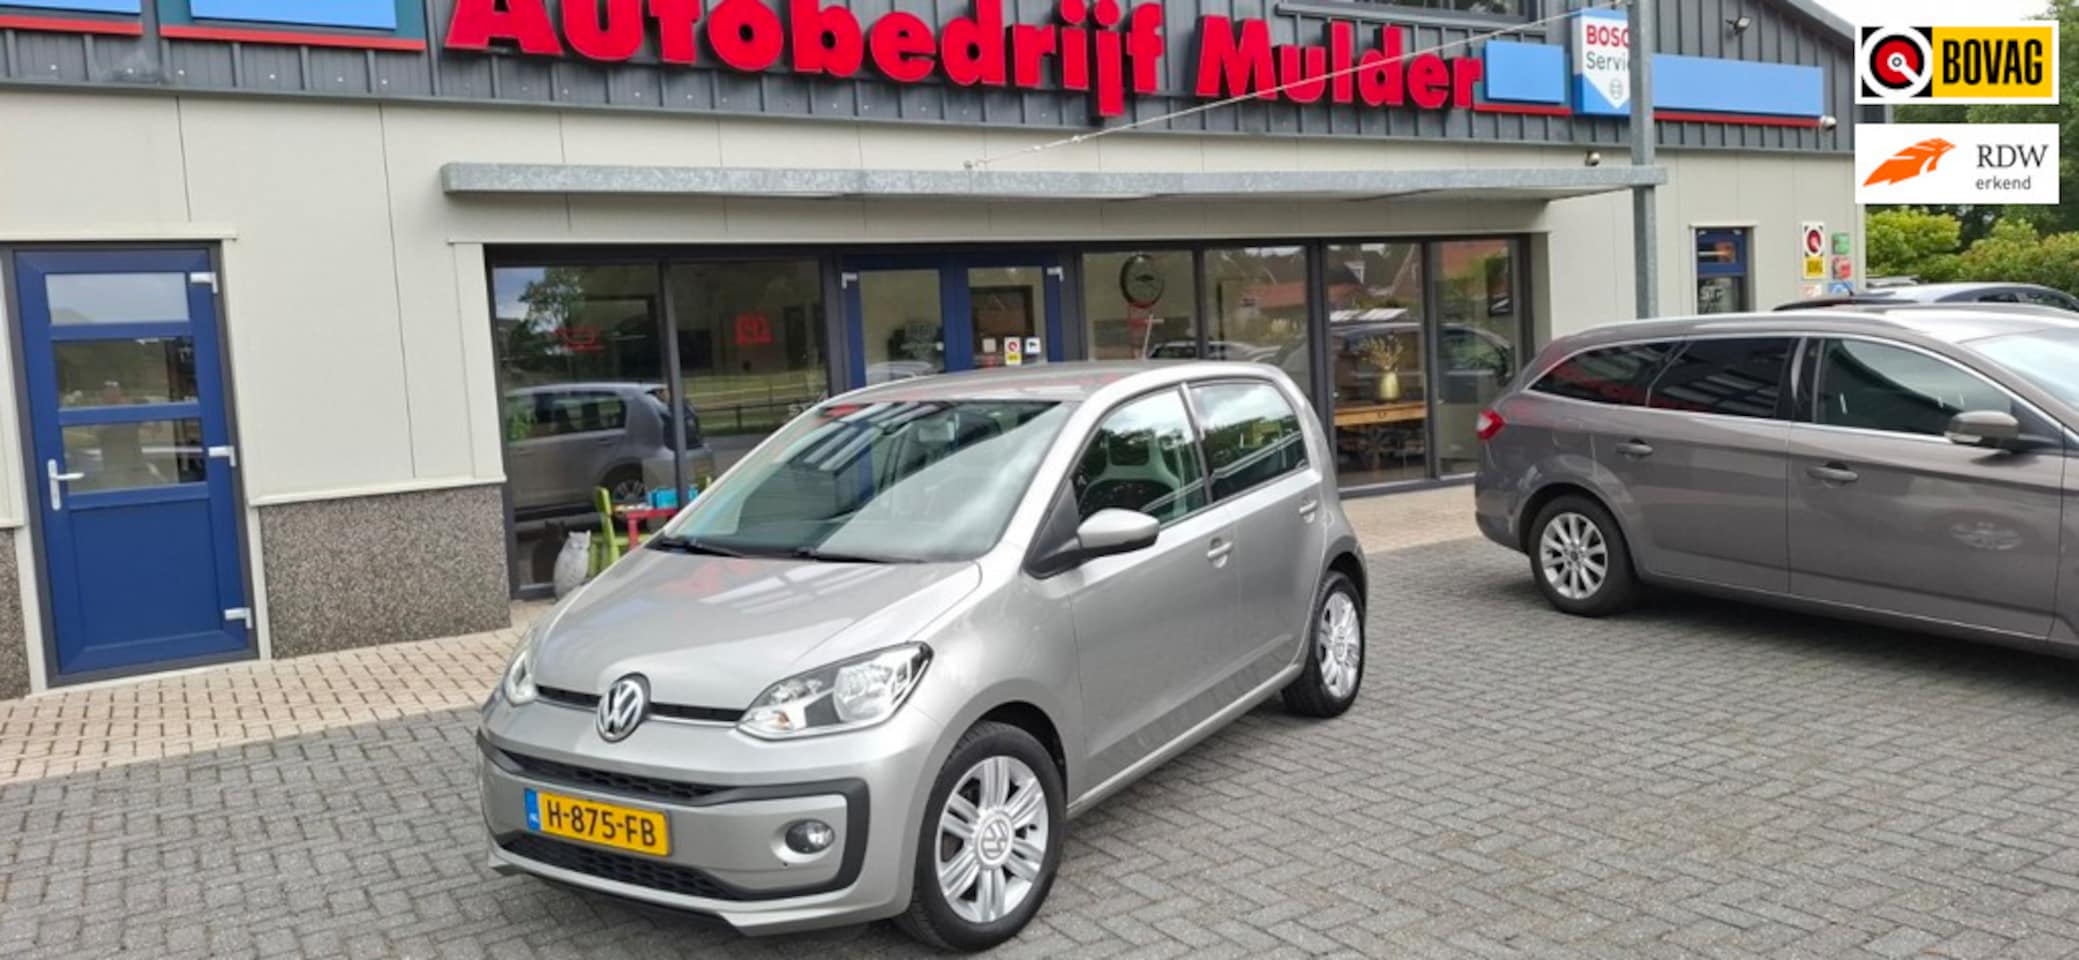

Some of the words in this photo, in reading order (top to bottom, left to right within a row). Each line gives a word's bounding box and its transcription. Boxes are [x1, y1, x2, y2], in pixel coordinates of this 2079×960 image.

[445, 0, 1164, 116] Autobedrijf
[1195, 14, 1482, 110] Mulder
[1586, 24, 1631, 48] BOSC
[547, 799, 656, 847] H-875-FB
